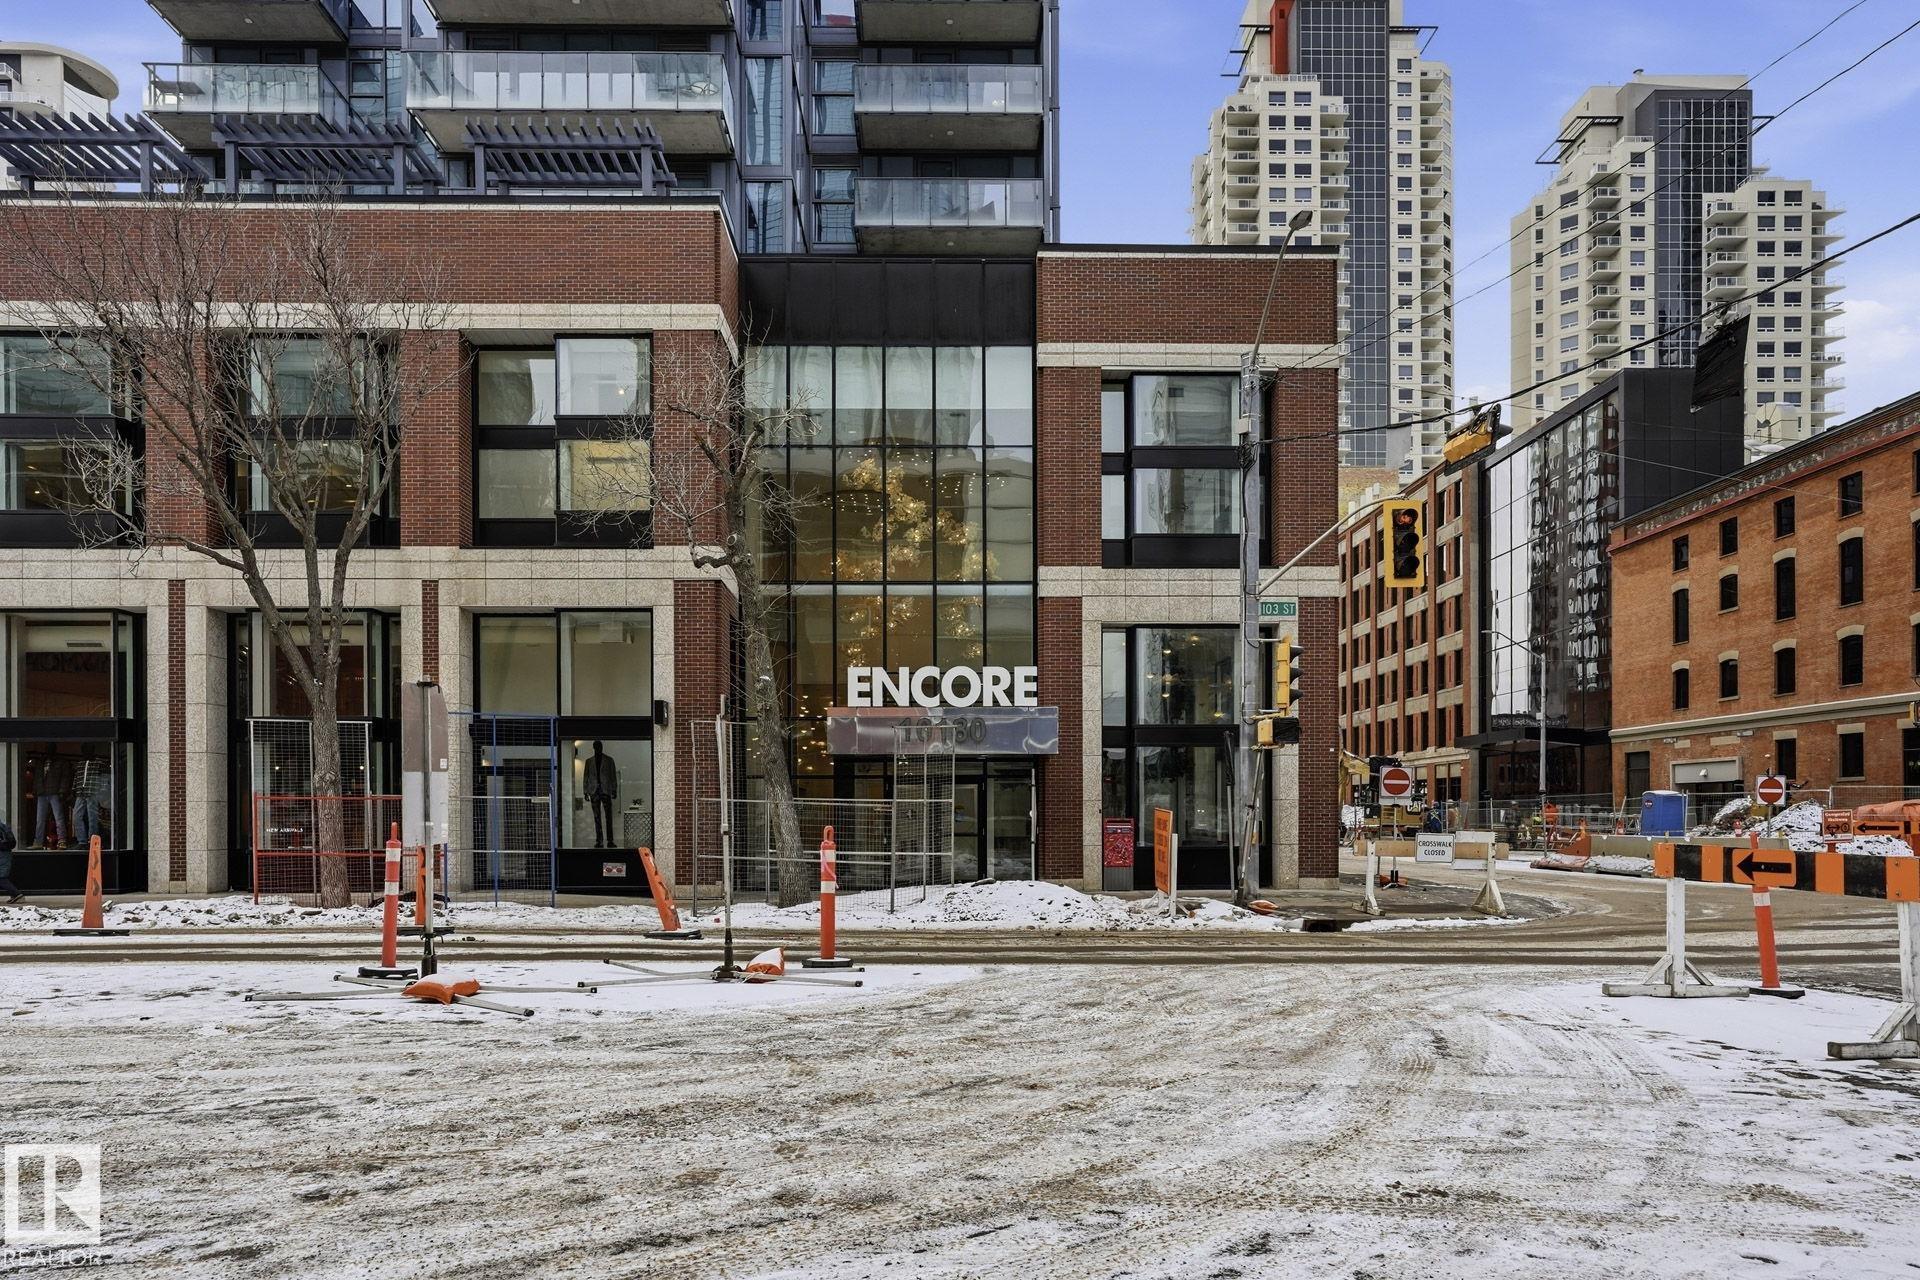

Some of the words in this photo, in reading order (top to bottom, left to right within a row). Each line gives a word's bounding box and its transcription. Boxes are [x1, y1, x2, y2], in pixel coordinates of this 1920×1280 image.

[1263, 603, 1279, 615] 103
[1283, 603, 1296, 615] ST
[847, 665, 1038, 708] ENCORE
[1407, 800, 1422, 812] CAT
[1418, 840, 1453, 848] CROSSWALK
